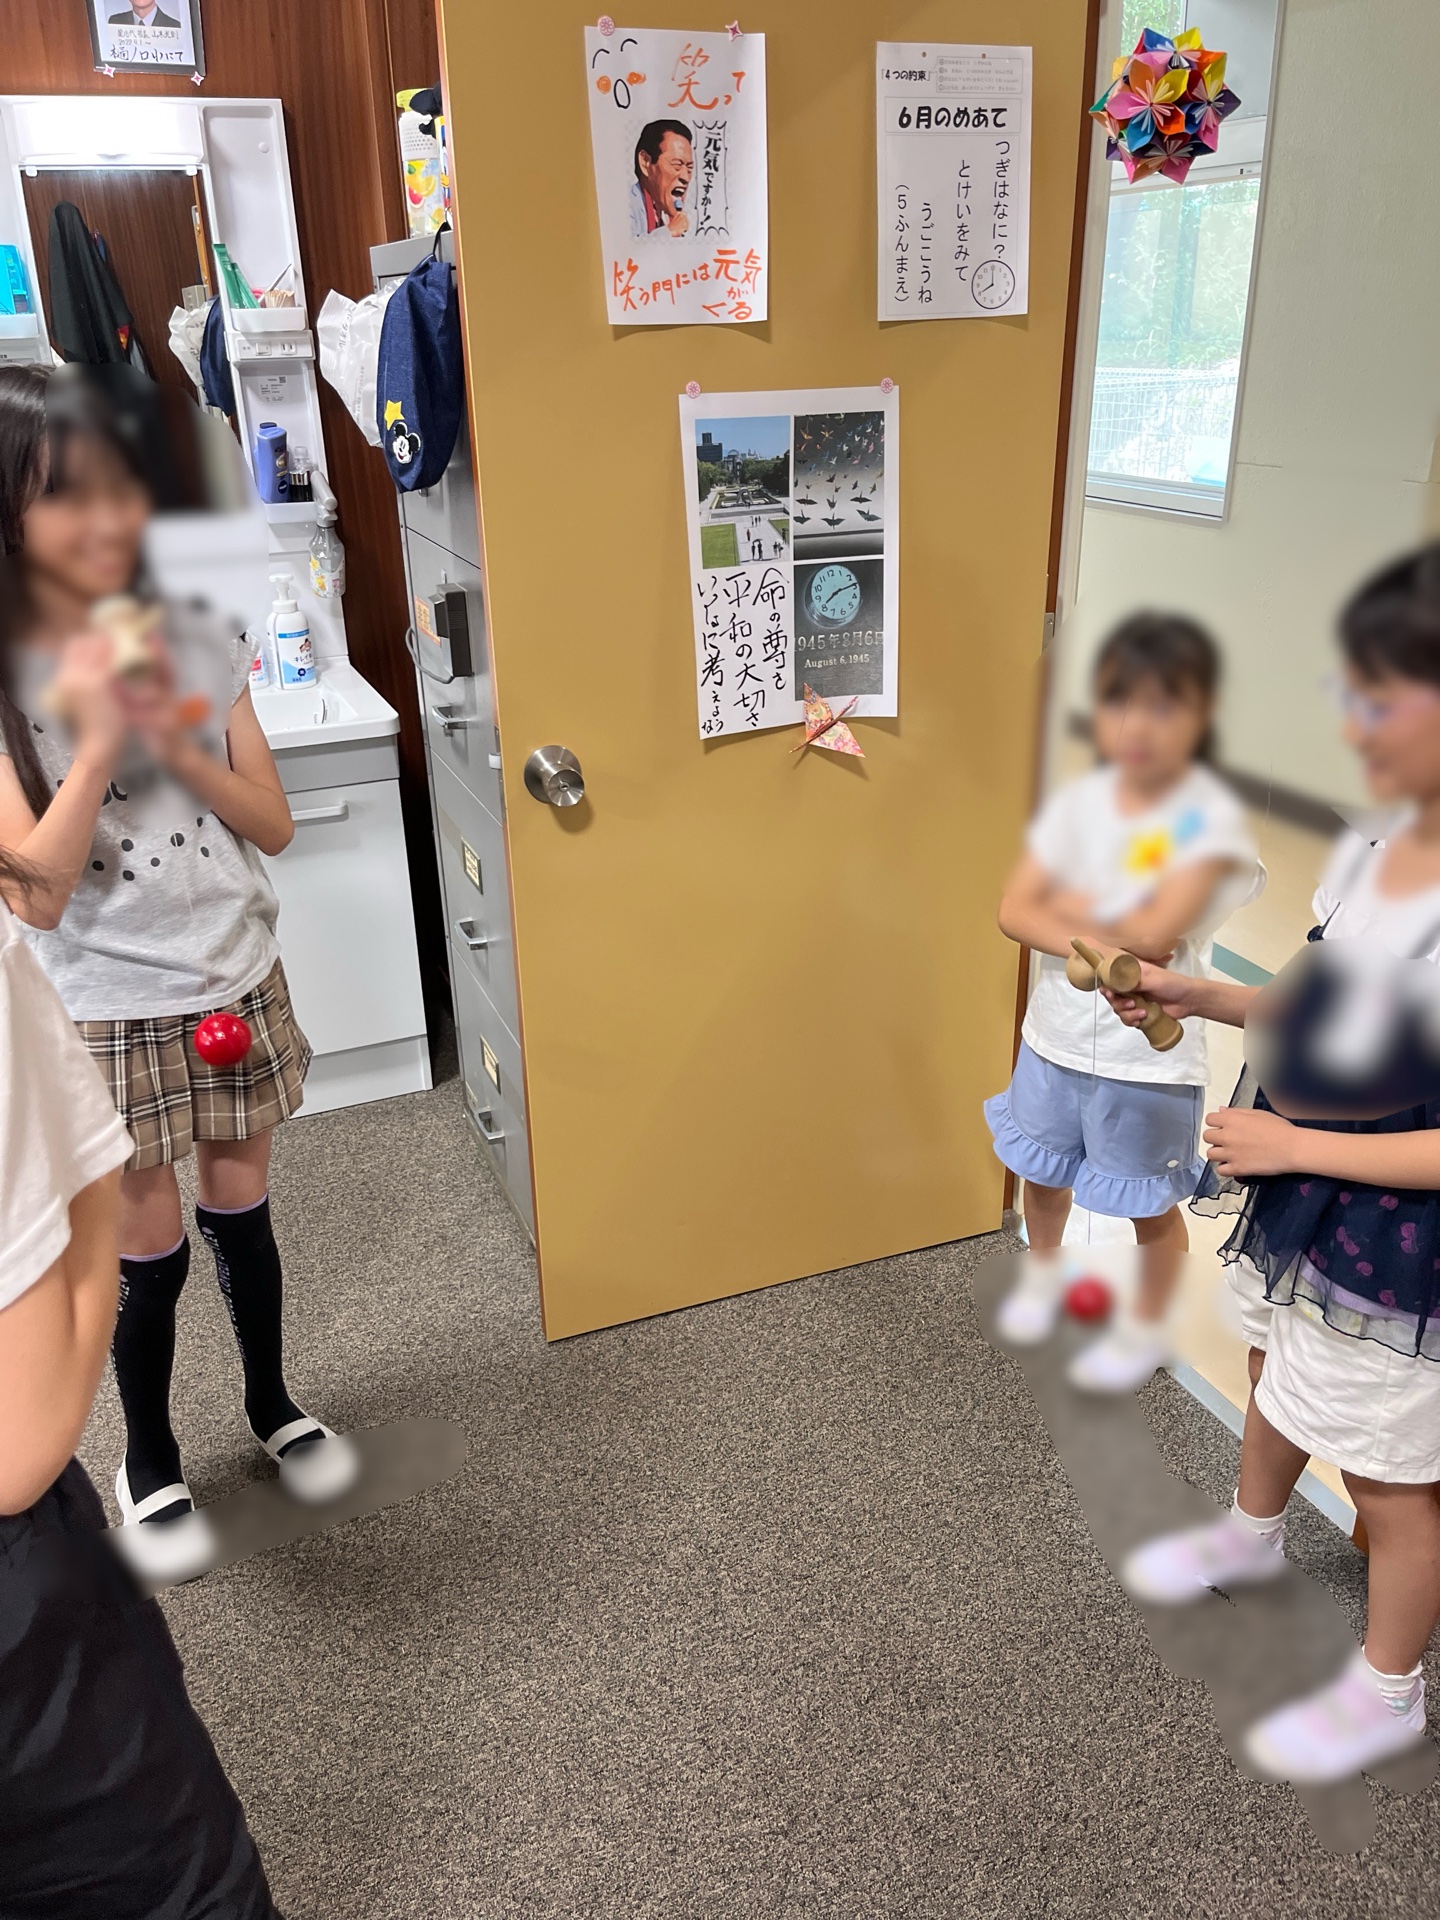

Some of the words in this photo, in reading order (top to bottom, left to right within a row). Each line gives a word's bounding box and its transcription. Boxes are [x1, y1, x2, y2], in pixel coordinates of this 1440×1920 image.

[668, 43, 746, 111] 笑って
[898, 105, 1008, 129] 6月のめあて
[992, 139, 1011, 260] つぎはなに？
[953, 159, 972, 282] とけいをみて
[917, 201, 935, 304] うごこうね
[826, 569, 835, 578] 12
[838, 569, 843, 577] 1
[819, 575, 826, 583] 11
[846, 574, 852, 582] 2
[814, 584, 823, 593] 10
[814, 595, 822, 603] 9
[851, 592, 858, 600] 4
[821, 603, 828, 613] 8
[848, 601, 854, 610] 5
[830, 608, 836, 617] 7
[840, 607, 847, 616] 6
[752, 567, 790, 690] 命の尊さ
[794, 630, 884, 652] 945年8月6日
[719, 571, 766, 727] 平和の大切さ
[804, 657, 837, 669] August
[839, 655, 847, 665] 6,
[848, 653, 870, 664] 1945
